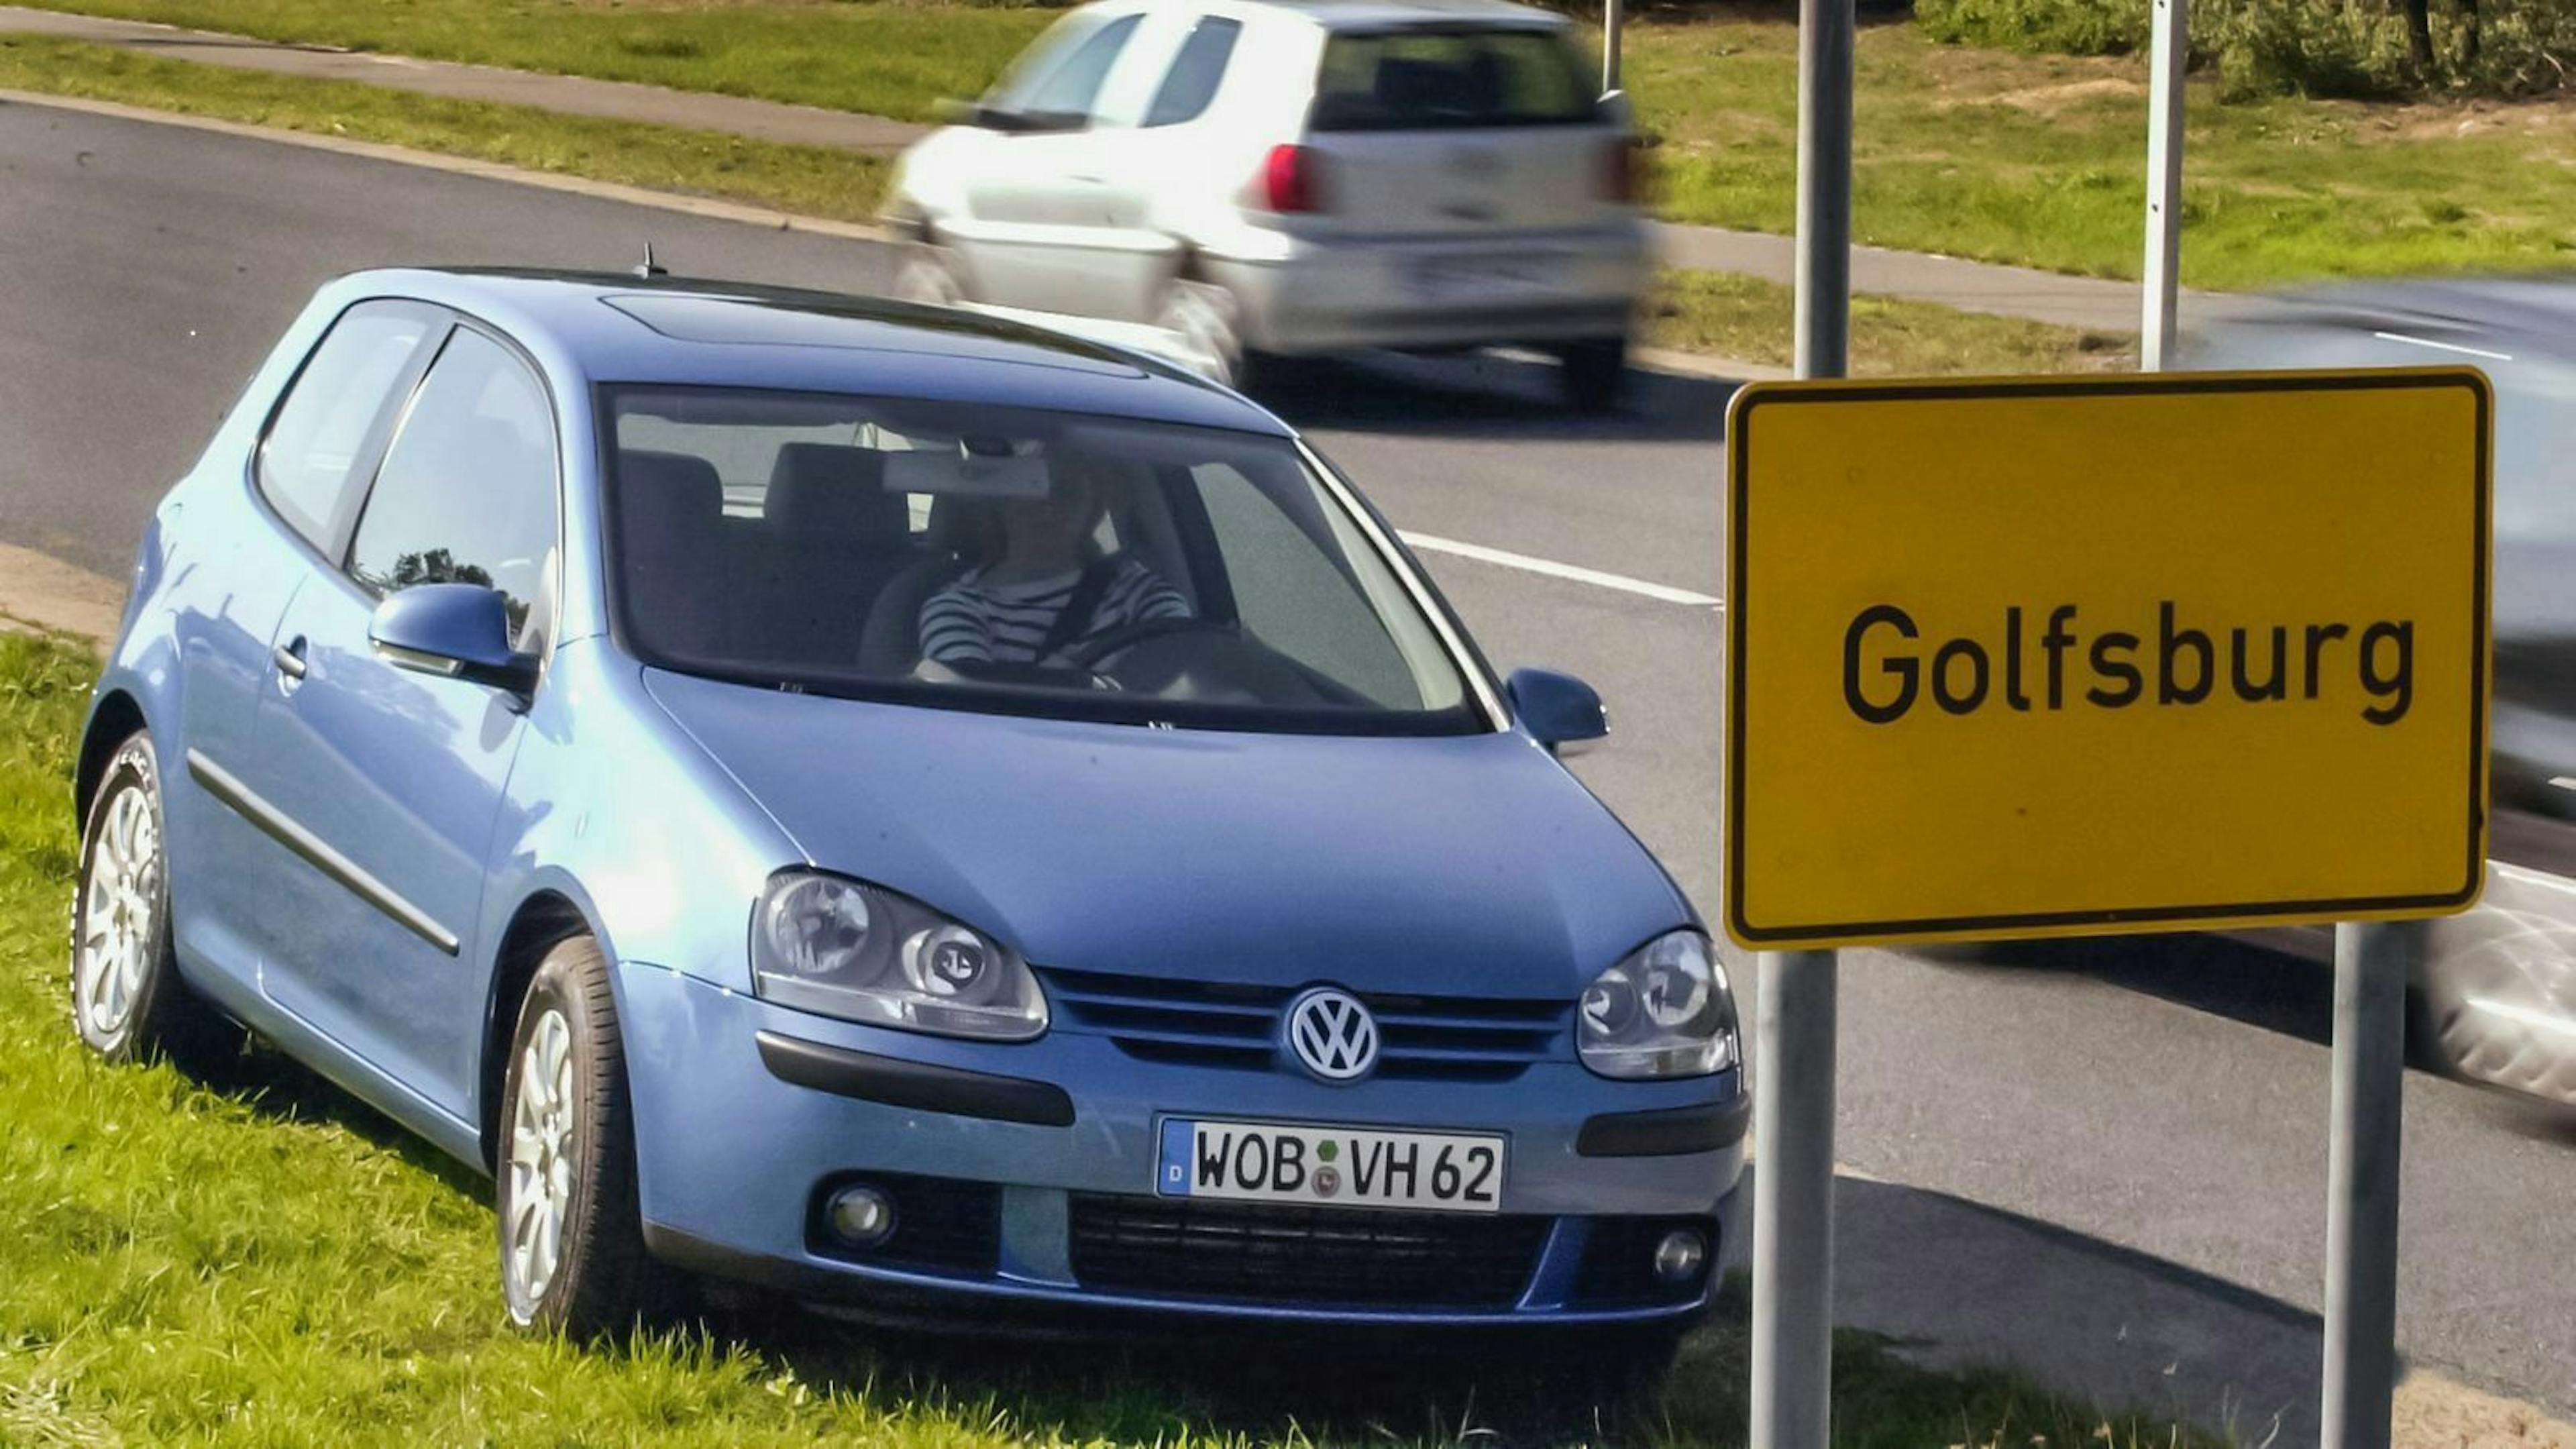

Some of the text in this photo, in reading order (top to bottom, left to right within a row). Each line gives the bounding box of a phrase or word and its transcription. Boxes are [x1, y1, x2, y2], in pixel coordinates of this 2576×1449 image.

[1842, 600, 2414, 727] Golfsburg
[1169, 1165, 1182, 1181] D
[1197, 1130, 1495, 1201] WOB VH 62
